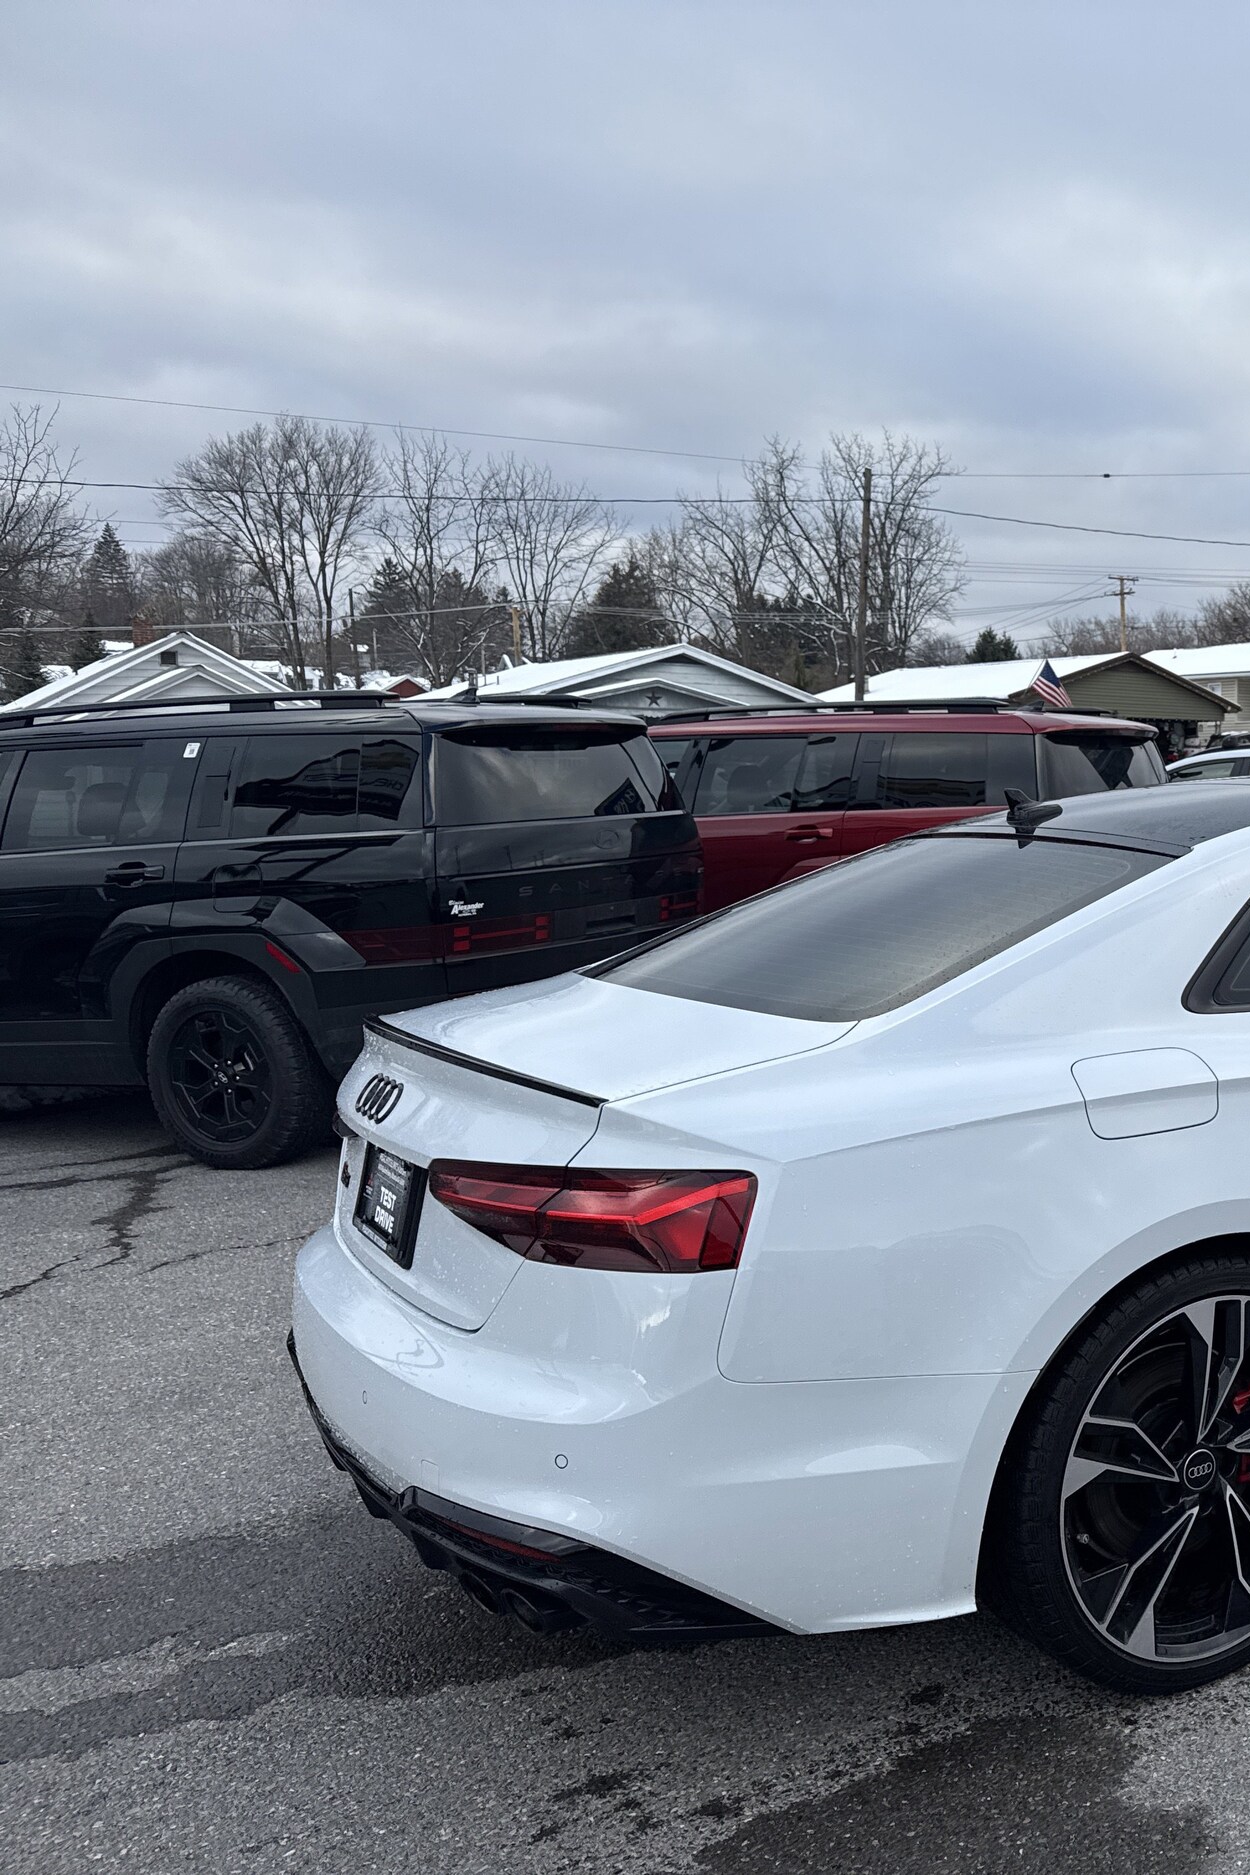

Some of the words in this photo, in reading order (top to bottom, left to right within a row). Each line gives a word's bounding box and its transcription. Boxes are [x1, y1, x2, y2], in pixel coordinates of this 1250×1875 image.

[450, 902, 485, 915] Alexander
[379, 1186, 397, 1211] TEST
[374, 1205, 395, 1234] DRIVE
